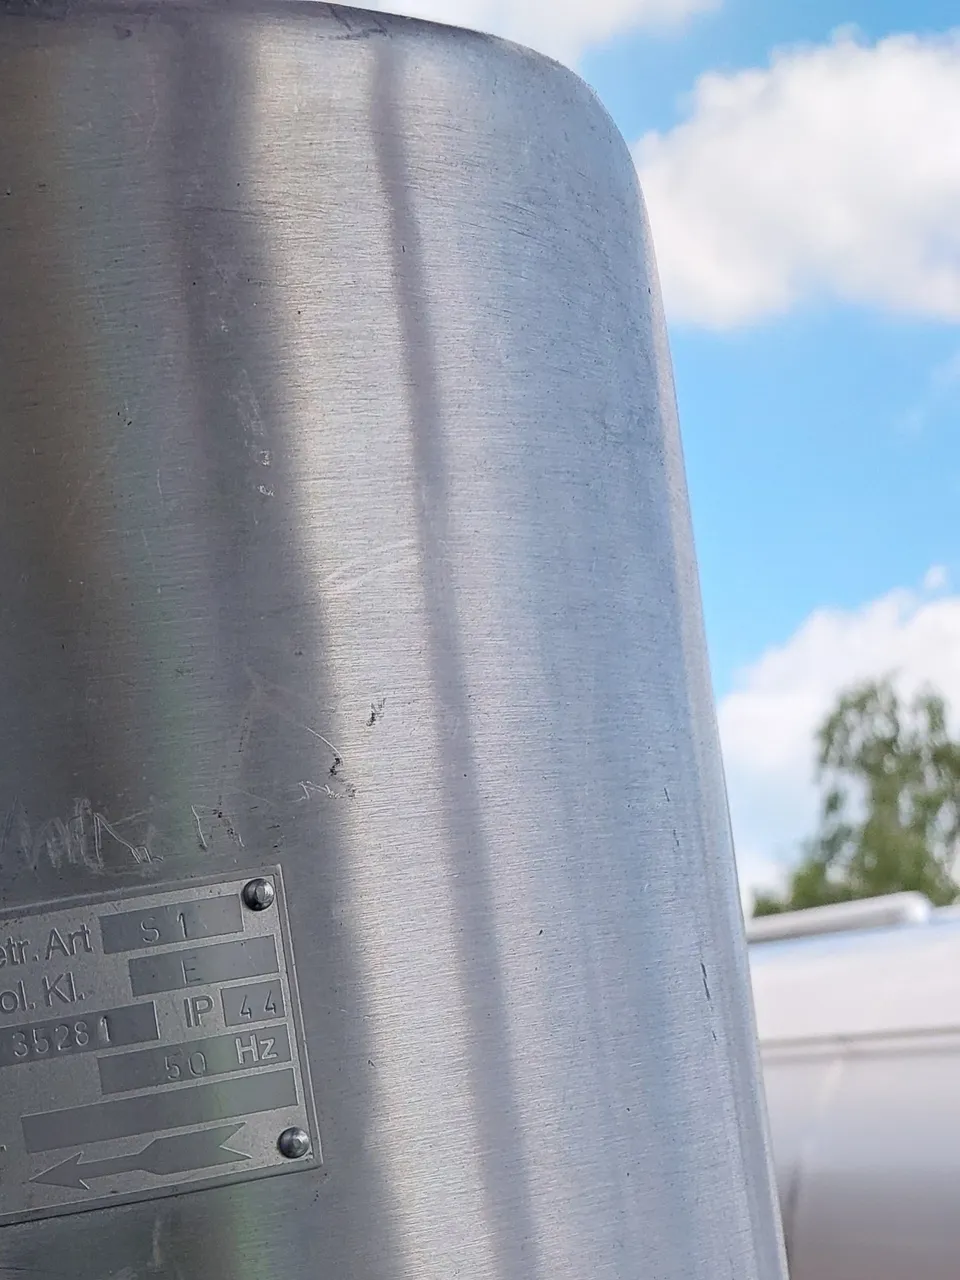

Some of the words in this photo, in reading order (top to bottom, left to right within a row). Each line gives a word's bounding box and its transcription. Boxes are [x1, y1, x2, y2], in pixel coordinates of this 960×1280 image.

[45, 923, 93, 960] Art
[42, 971, 85, 1008] Kl.
[184, 994, 215, 1028] IP
[12, 1015, 110, 1057] 35281
[164, 1051, 208, 1080] 50
[234, 1033, 278, 1065] Hz
